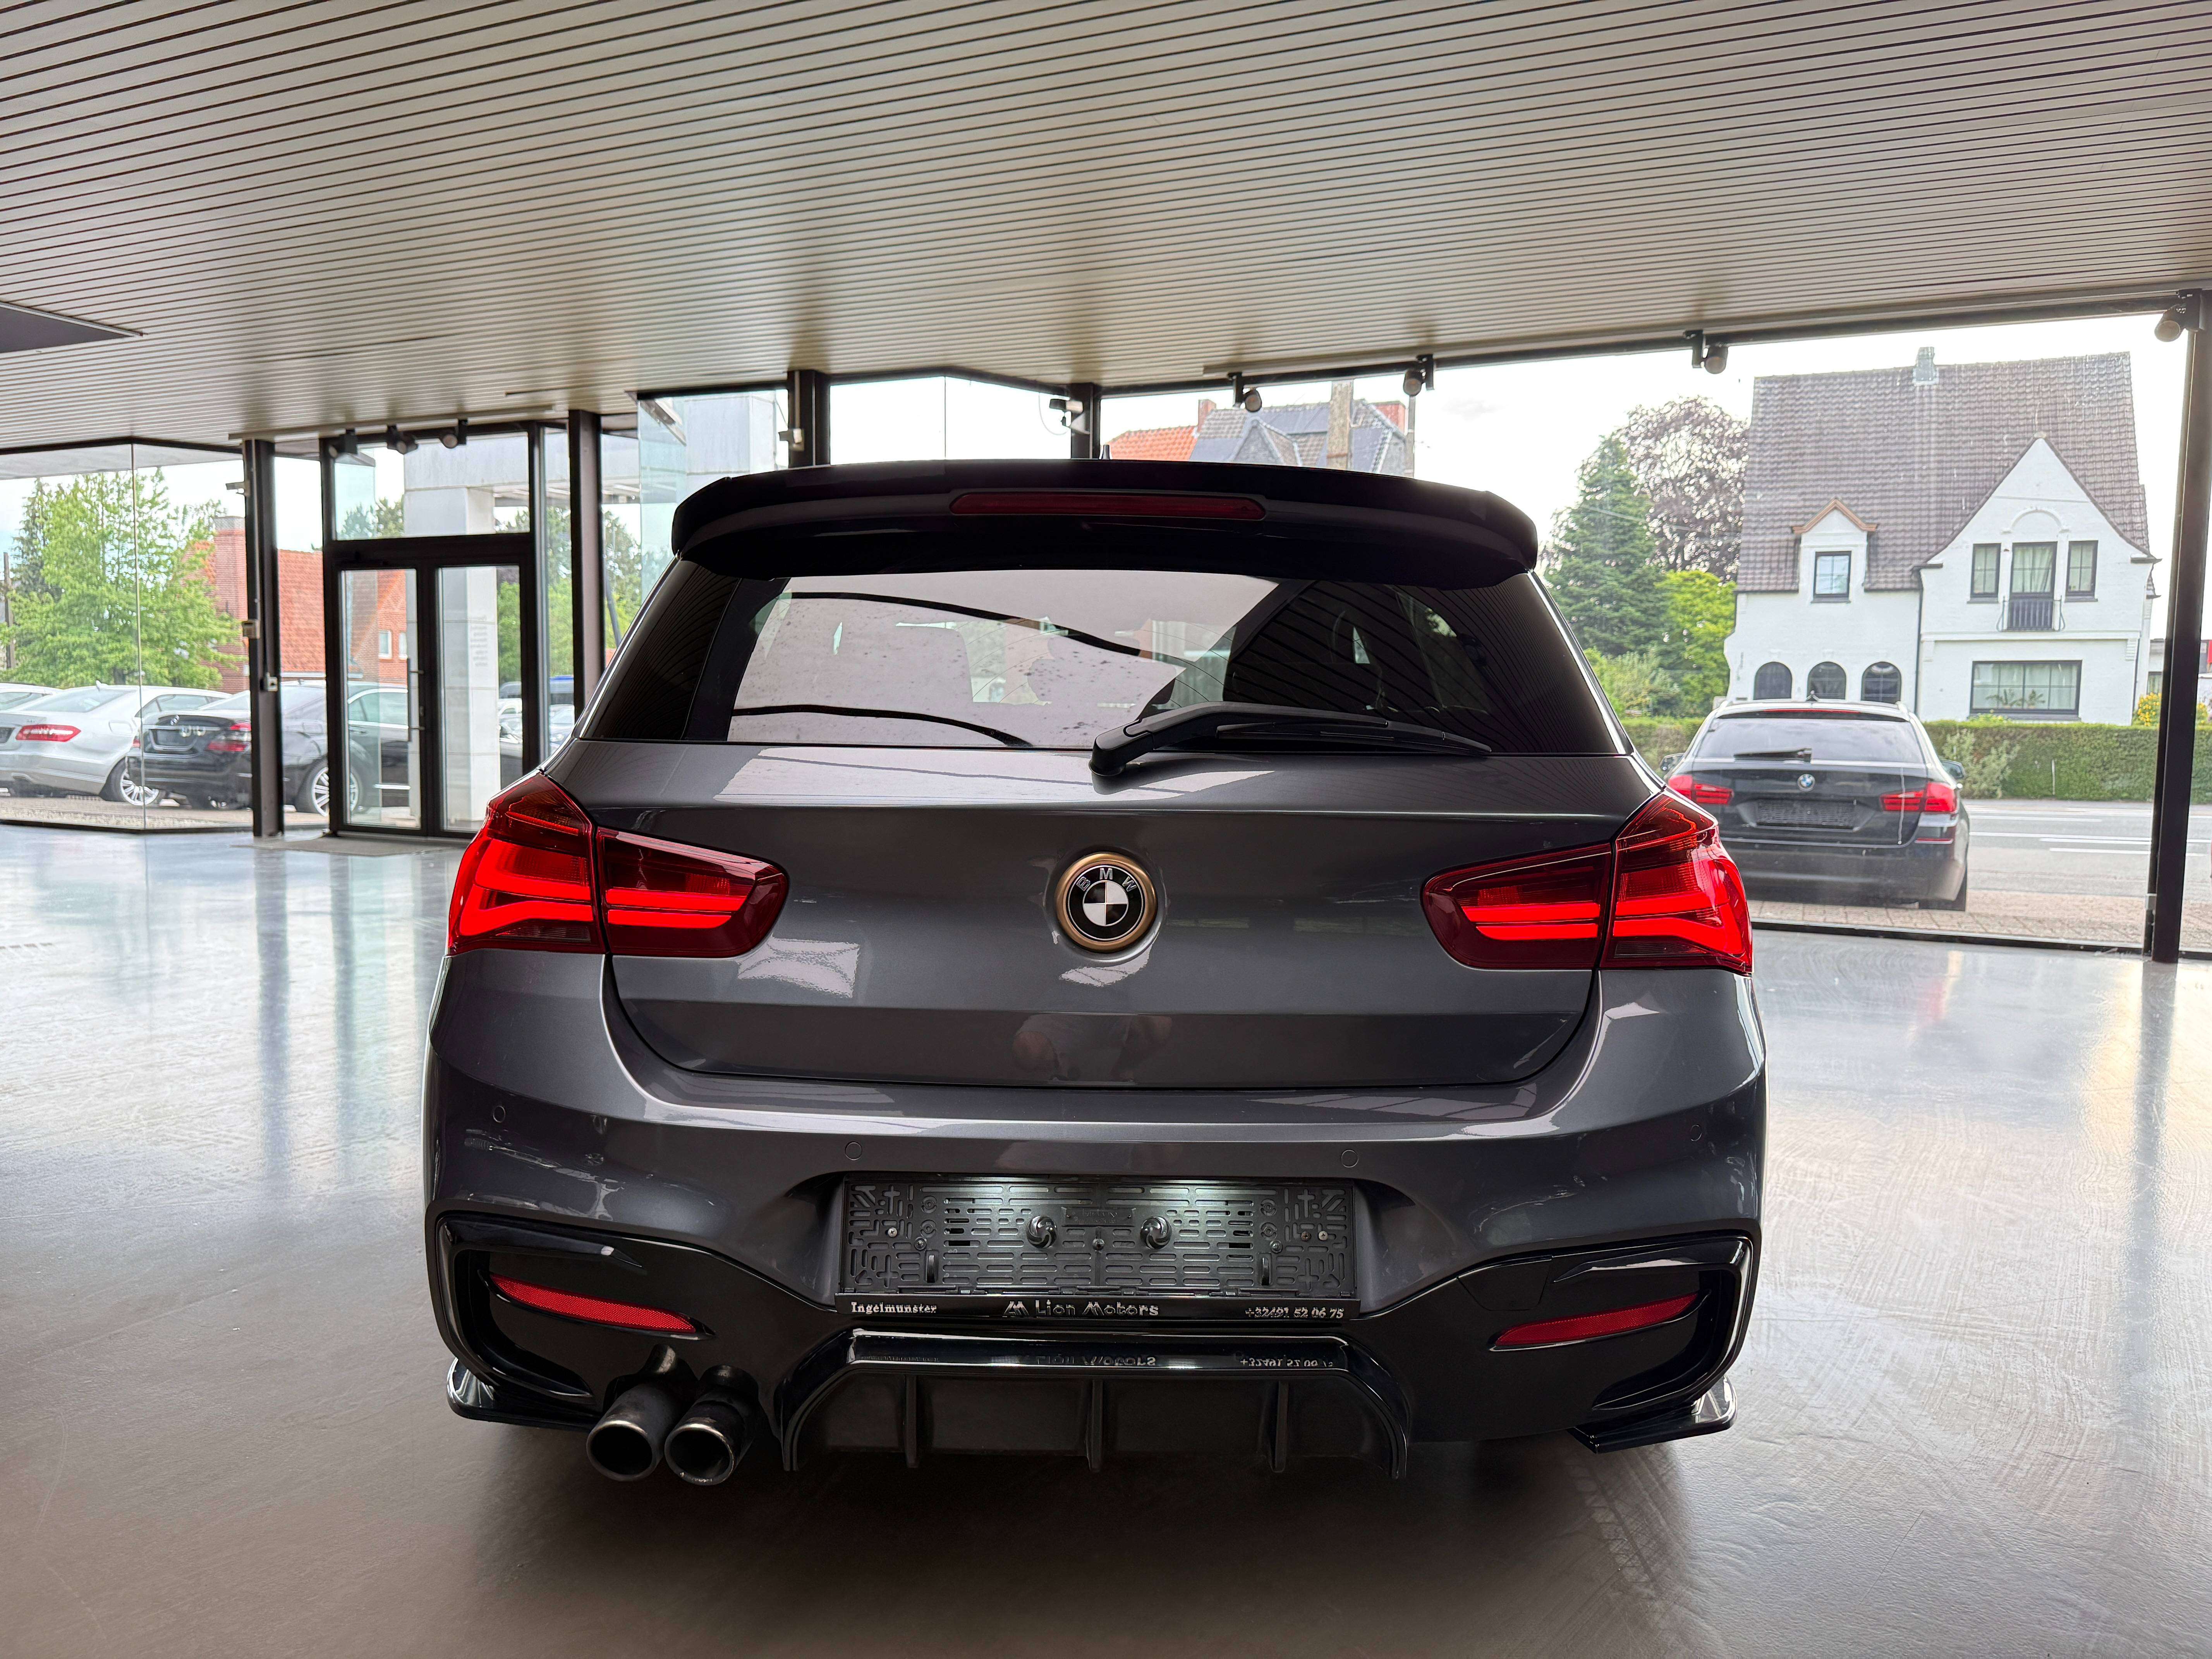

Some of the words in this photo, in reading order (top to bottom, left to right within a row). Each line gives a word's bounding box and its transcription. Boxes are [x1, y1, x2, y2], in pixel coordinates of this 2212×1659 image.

[1077, 868, 1137, 891] BMW
[851, 1302, 937, 1314] Ingelmunster
[1035, 1299, 1075, 1316] Lion
[1082, 1301, 1159, 1316] Motors
[1245, 1307, 1290, 1317] +32491
[1293, 1307, 1308, 1318] 52
[1311, 1307, 1326, 1318] 06
[1329, 1307, 1344, 1319] 75
